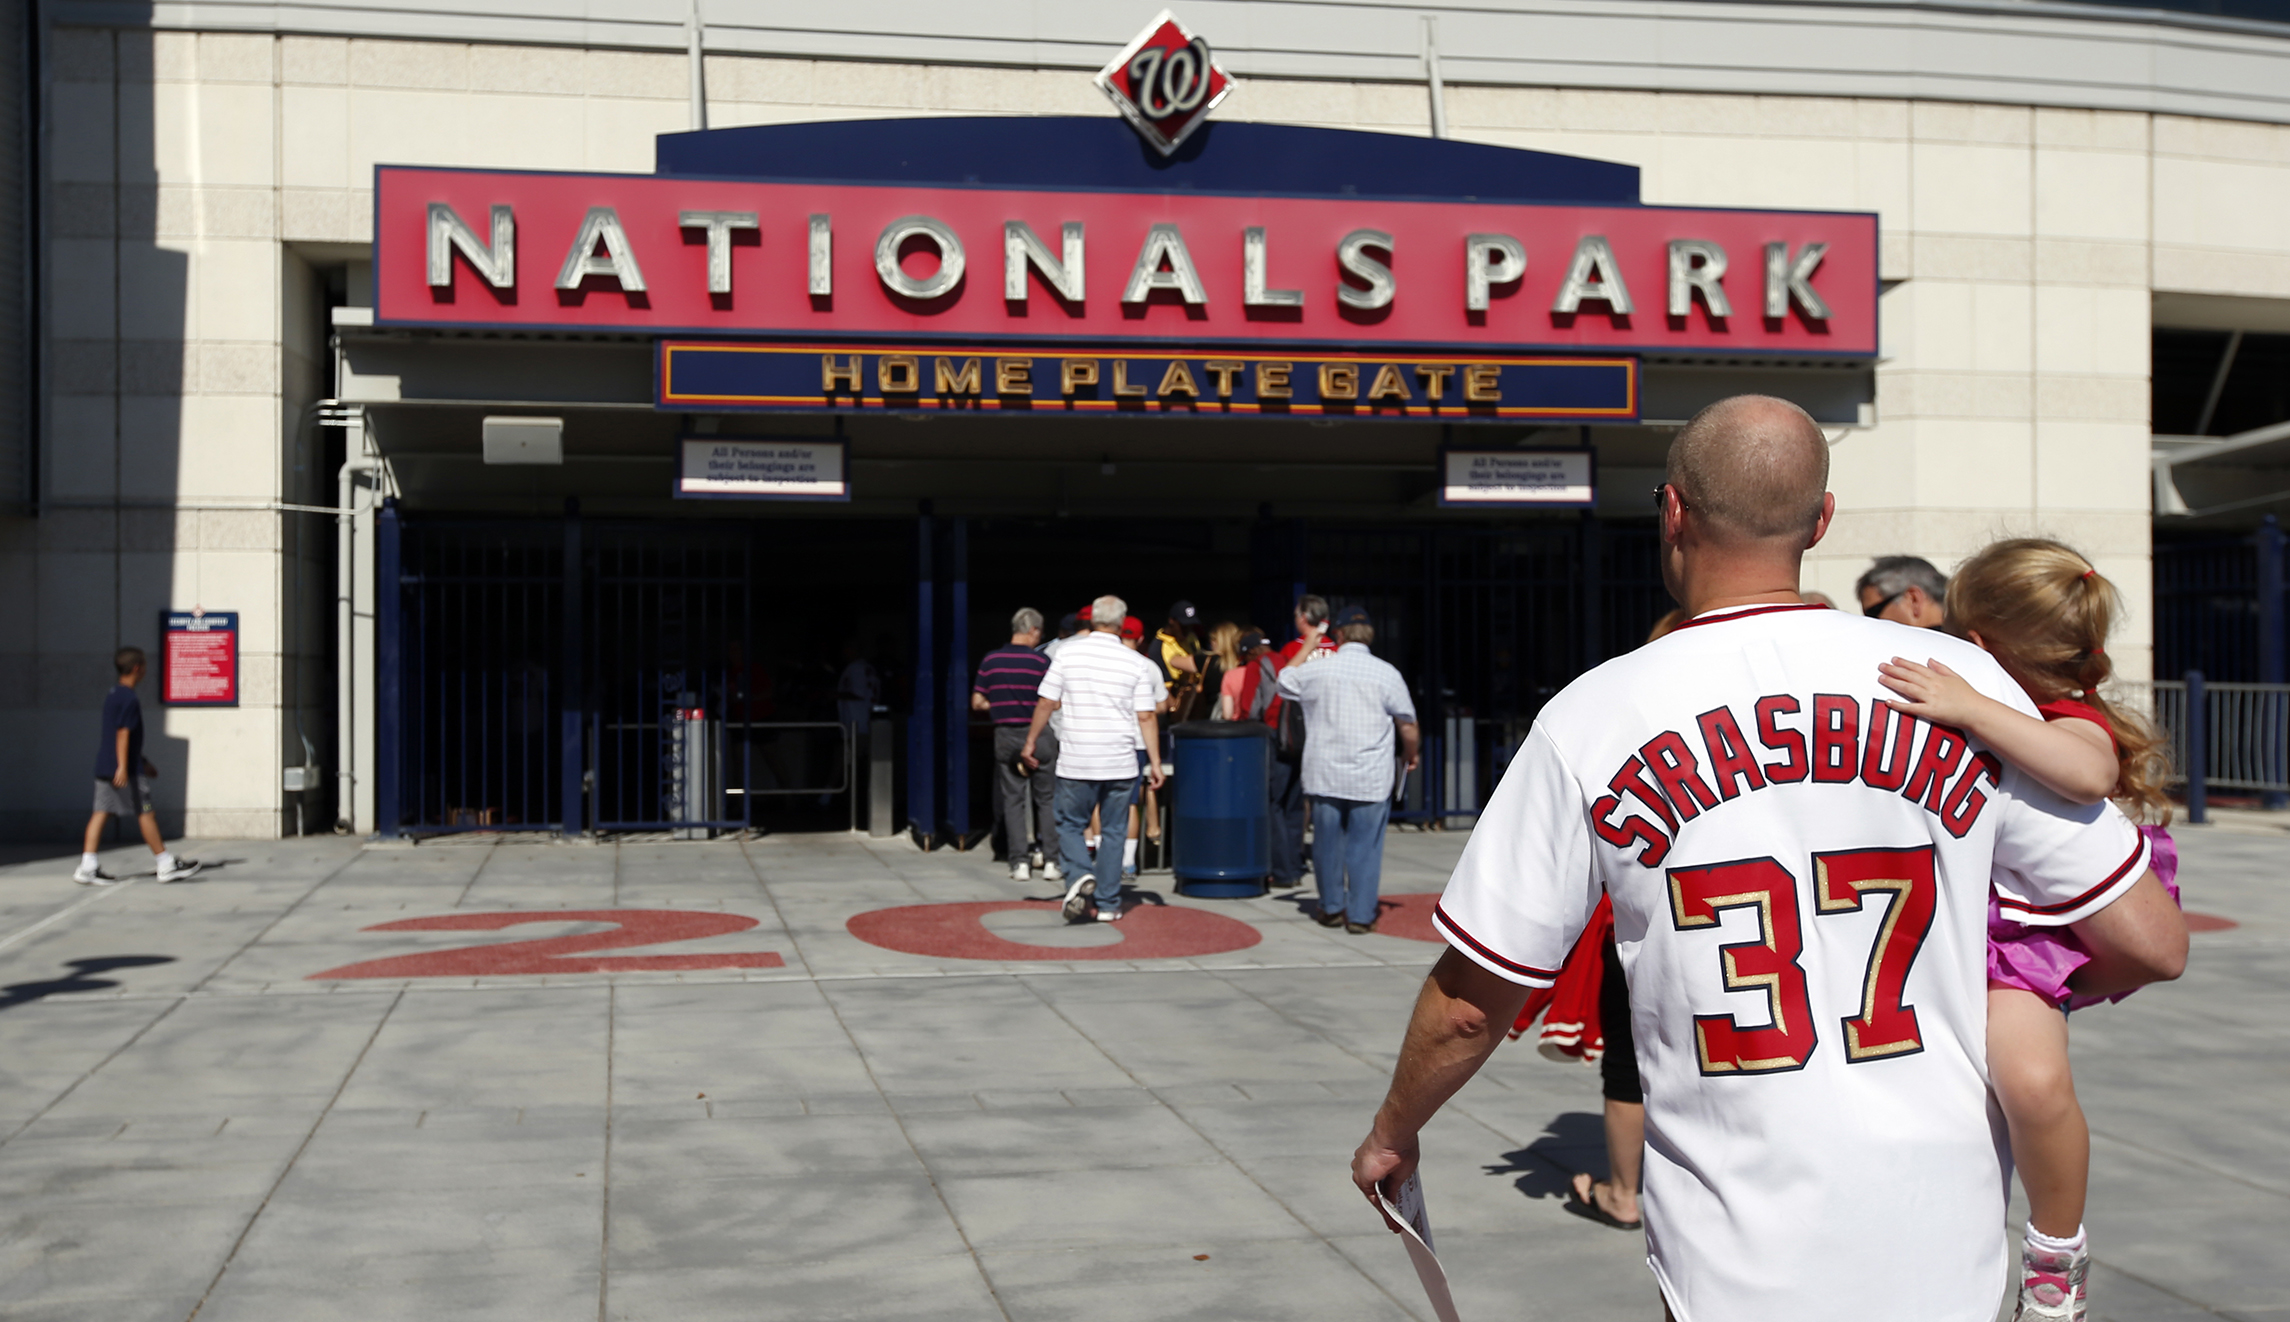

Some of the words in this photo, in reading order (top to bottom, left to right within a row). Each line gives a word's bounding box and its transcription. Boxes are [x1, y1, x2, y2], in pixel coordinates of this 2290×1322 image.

[1129, 36, 1210, 119] W
[426, 202, 1396, 310] NATIONALS
[1465, 233, 1832, 320] PARK
[822, 353, 1034, 394] HOME
[1060, 358, 1293, 398] PLATE
[1317, 361, 1502, 400] GATE
[708, 460, 734, 470] their
[737, 460, 795, 473] belongings
[798, 463, 816, 472] are
[711, 447, 729, 457] All
[731, 447, 774, 458] Persons
[777, 449, 812, 459] and/or
[1590, 693, 2002, 868] STRASBURG
[1666, 843, 1938, 1077] 37
